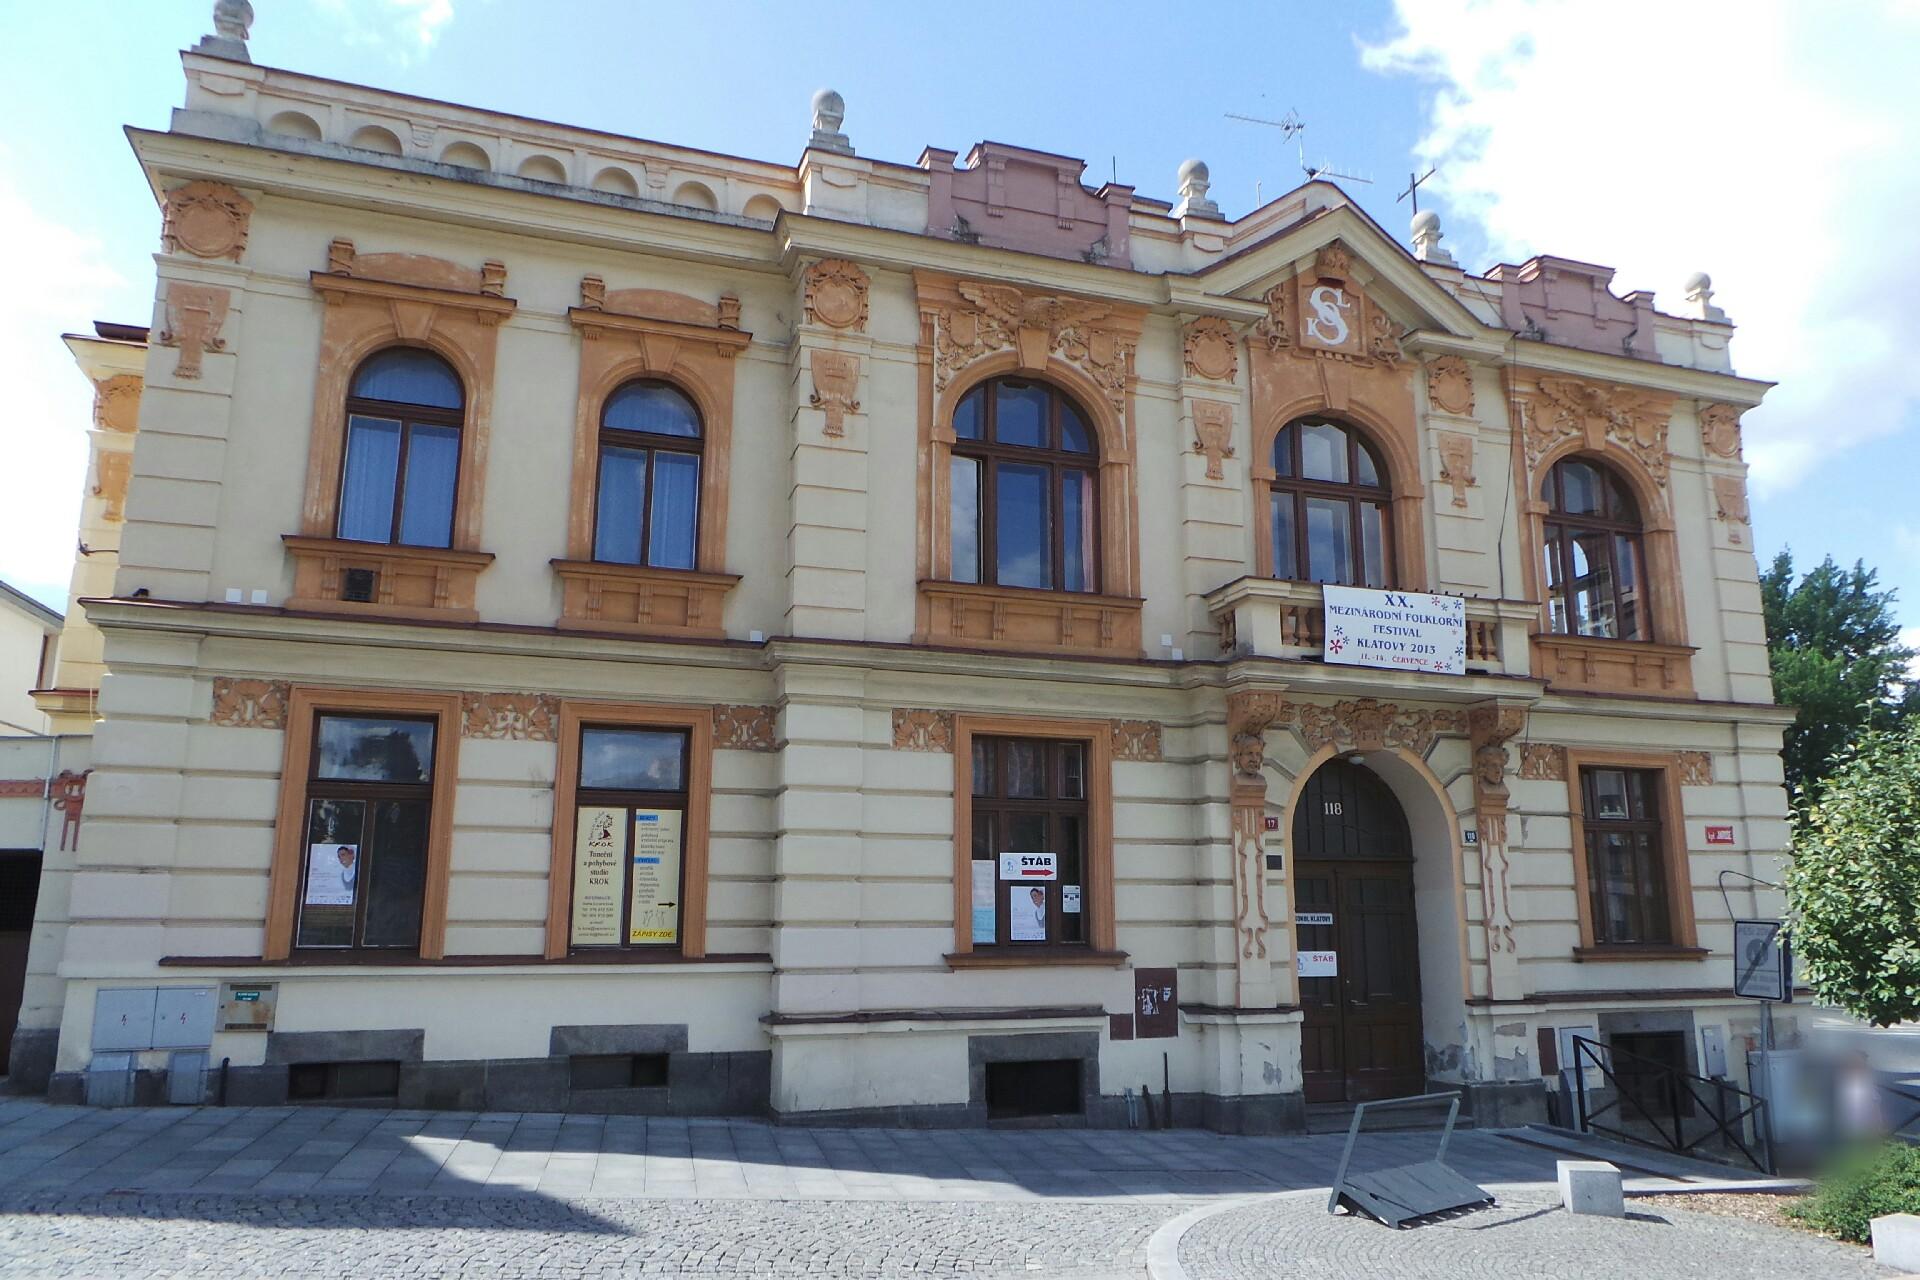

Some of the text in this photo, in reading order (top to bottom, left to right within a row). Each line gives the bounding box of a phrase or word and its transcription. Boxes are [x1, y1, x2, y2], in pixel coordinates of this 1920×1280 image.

[1385, 594, 1414, 609] XX.
[1329, 605, 1463, 628] MEZINÁRODNÍ FOLKLORNÍ
[1373, 624, 1422, 638] FESTIVAL
[1357, 638, 1436, 655] KLATOVY 2013
[1392, 653, 1429, 666] ČERVENCE
[1324, 802, 1342, 815] 118
[1268, 819, 1275, 828] 17
[589, 850, 613, 859] Taneční
[588, 859, 617, 868] pohybové
[1021, 855, 1052, 866] ŠTÁB
[590, 868, 609, 876] studio
[589, 877, 610, 886] KROK
[1312, 954, 1334, 963] ŠTÁB
